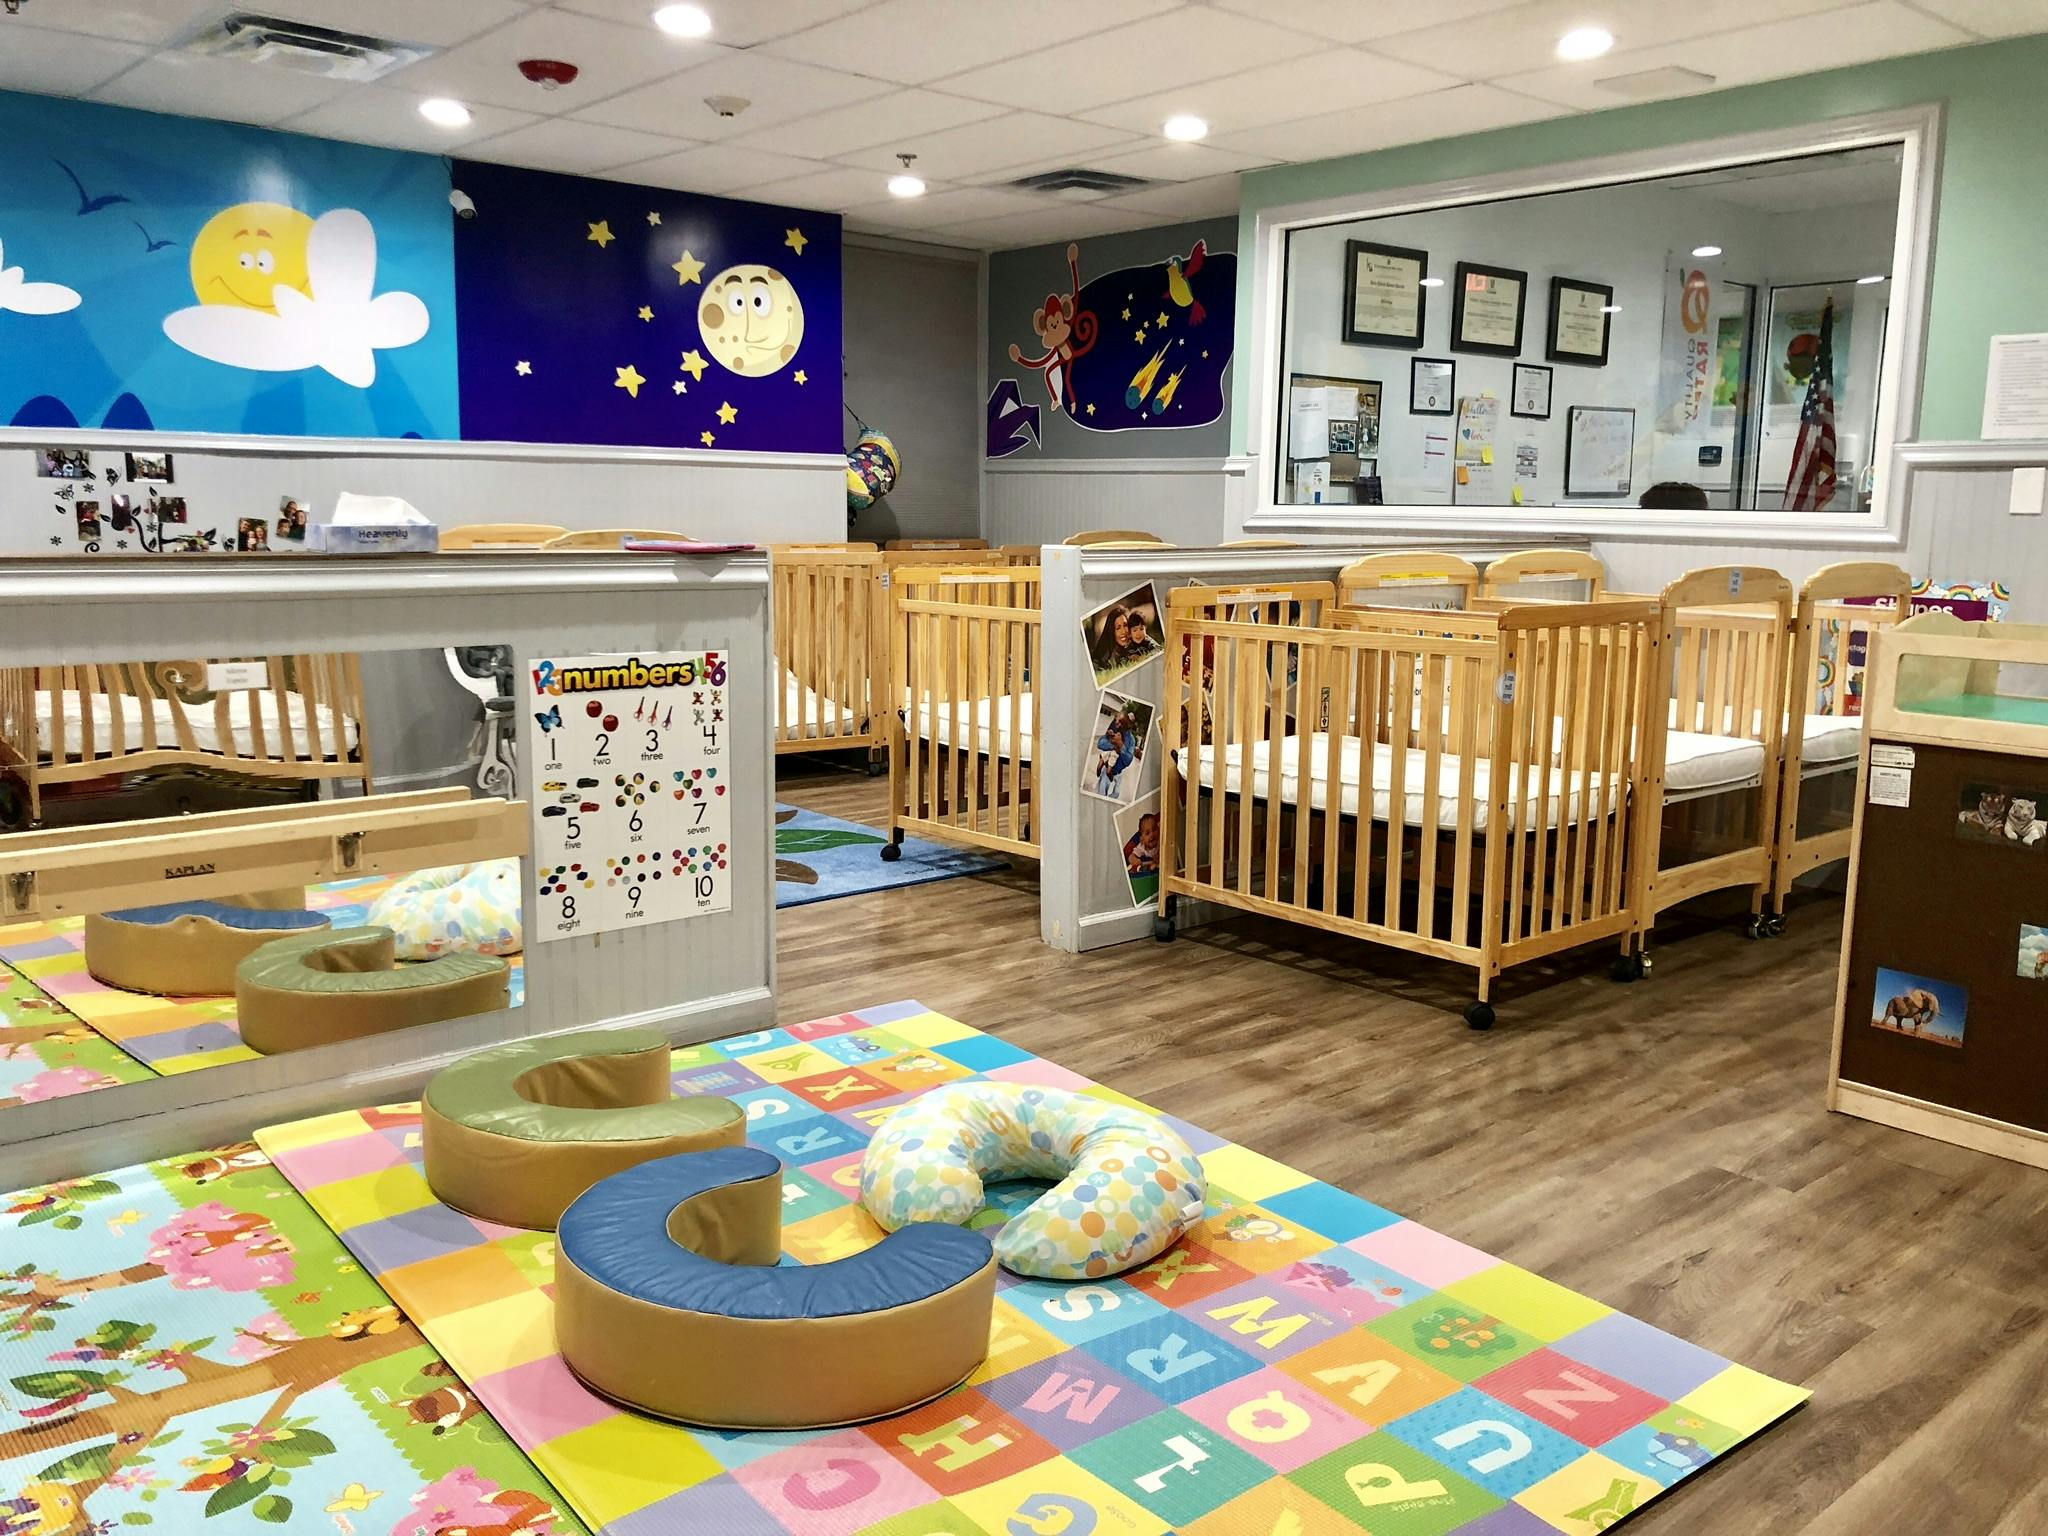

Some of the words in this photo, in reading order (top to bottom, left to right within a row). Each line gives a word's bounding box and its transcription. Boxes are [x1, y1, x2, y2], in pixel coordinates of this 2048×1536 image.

[358, 529, 408, 539] Heavenly
[562, 658, 694, 692] numbers
[645, 729, 660, 752] 3
[703, 725, 717, 746] 4
[595, 733, 610, 757] 2
[702, 746, 721, 756] four
[592, 757, 612, 766] two
[640, 751, 664, 762] three
[544, 761, 563, 771] one
[693, 802, 707, 825] 7
[567, 816, 581, 840] 5
[629, 810, 643, 832] 6
[686, 825, 711, 836] seven
[563, 840, 582, 850] five
[630, 833, 643, 843] six
[165, 863, 216, 879] KAPLAN
[695, 875, 714, 899] 10
[628, 886, 642, 909] 9
[697, 898, 711, 908] ten
[562, 896, 576, 919] 8
[625, 909, 644, 919] nine
[557, 919, 581, 932] eight
